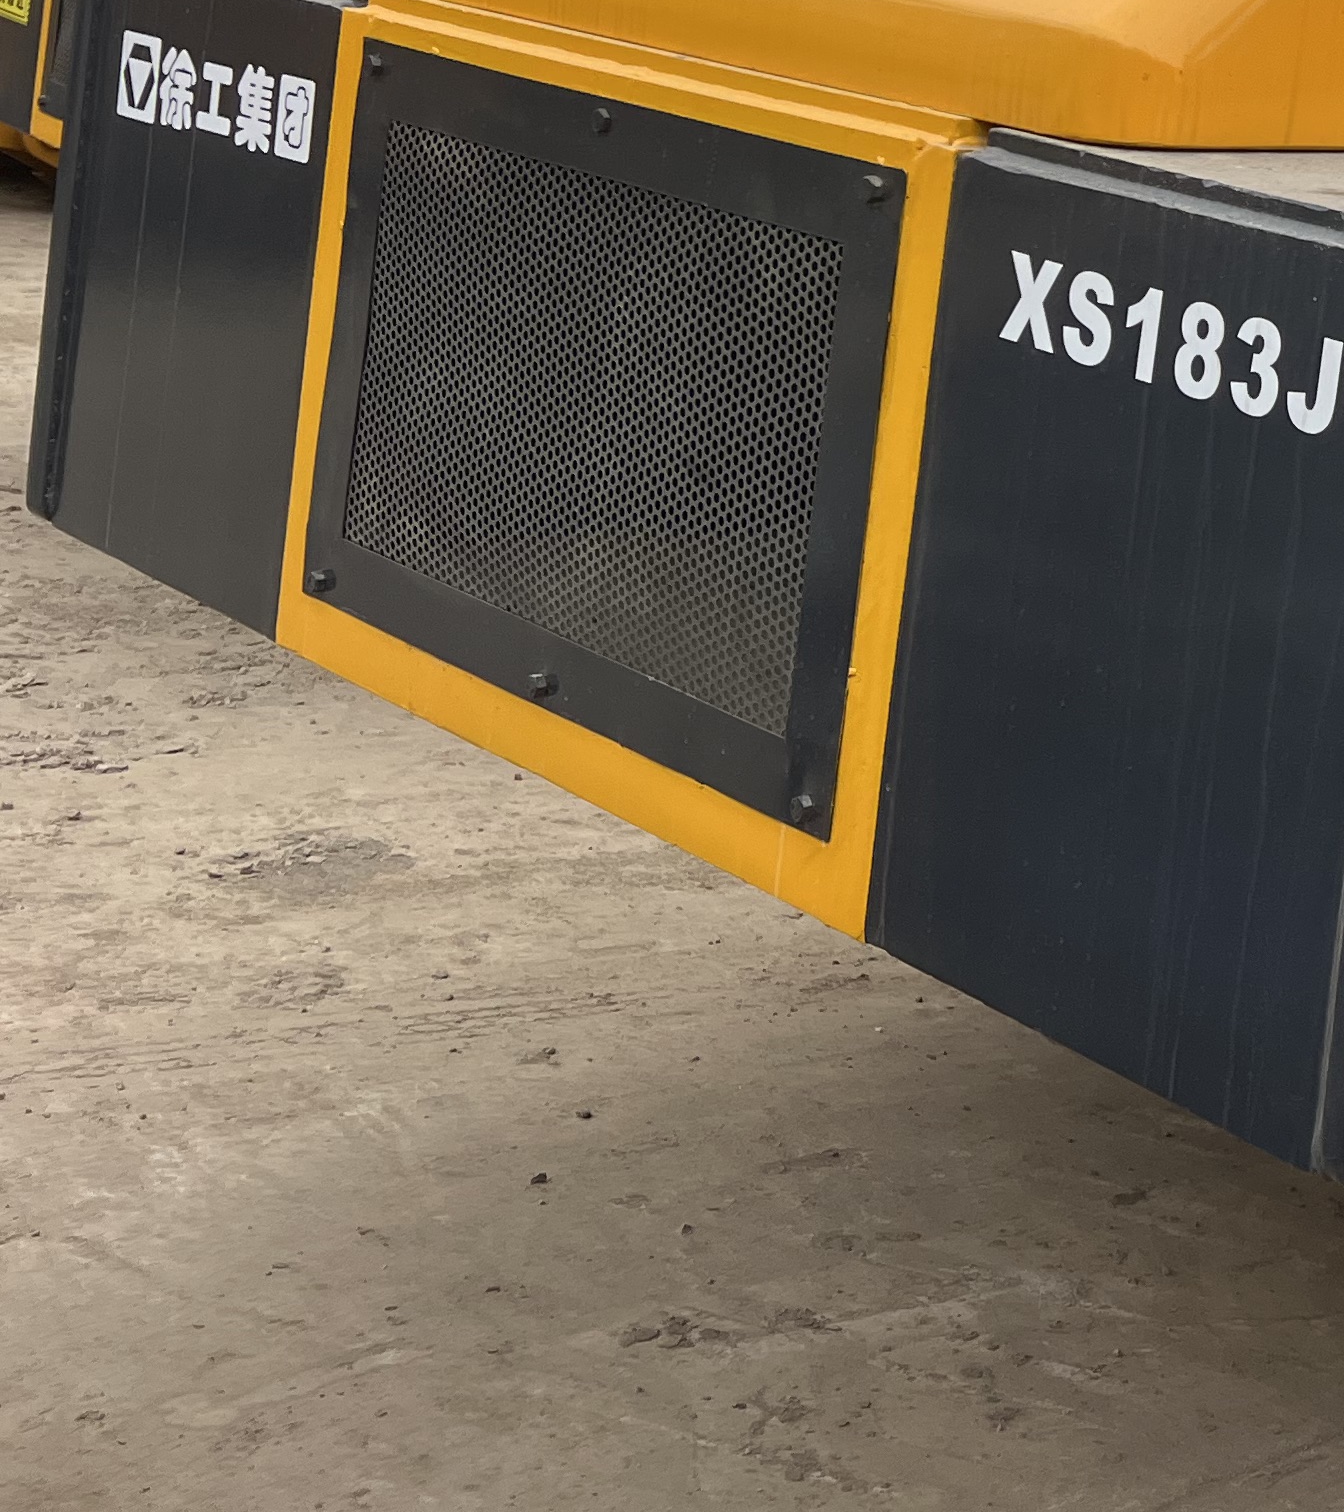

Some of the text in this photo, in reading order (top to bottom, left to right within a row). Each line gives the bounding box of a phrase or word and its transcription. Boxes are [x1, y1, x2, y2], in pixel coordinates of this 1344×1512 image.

[159, 45, 317, 164] 徐工集团
[998, 249, 1344, 435] XS183J
